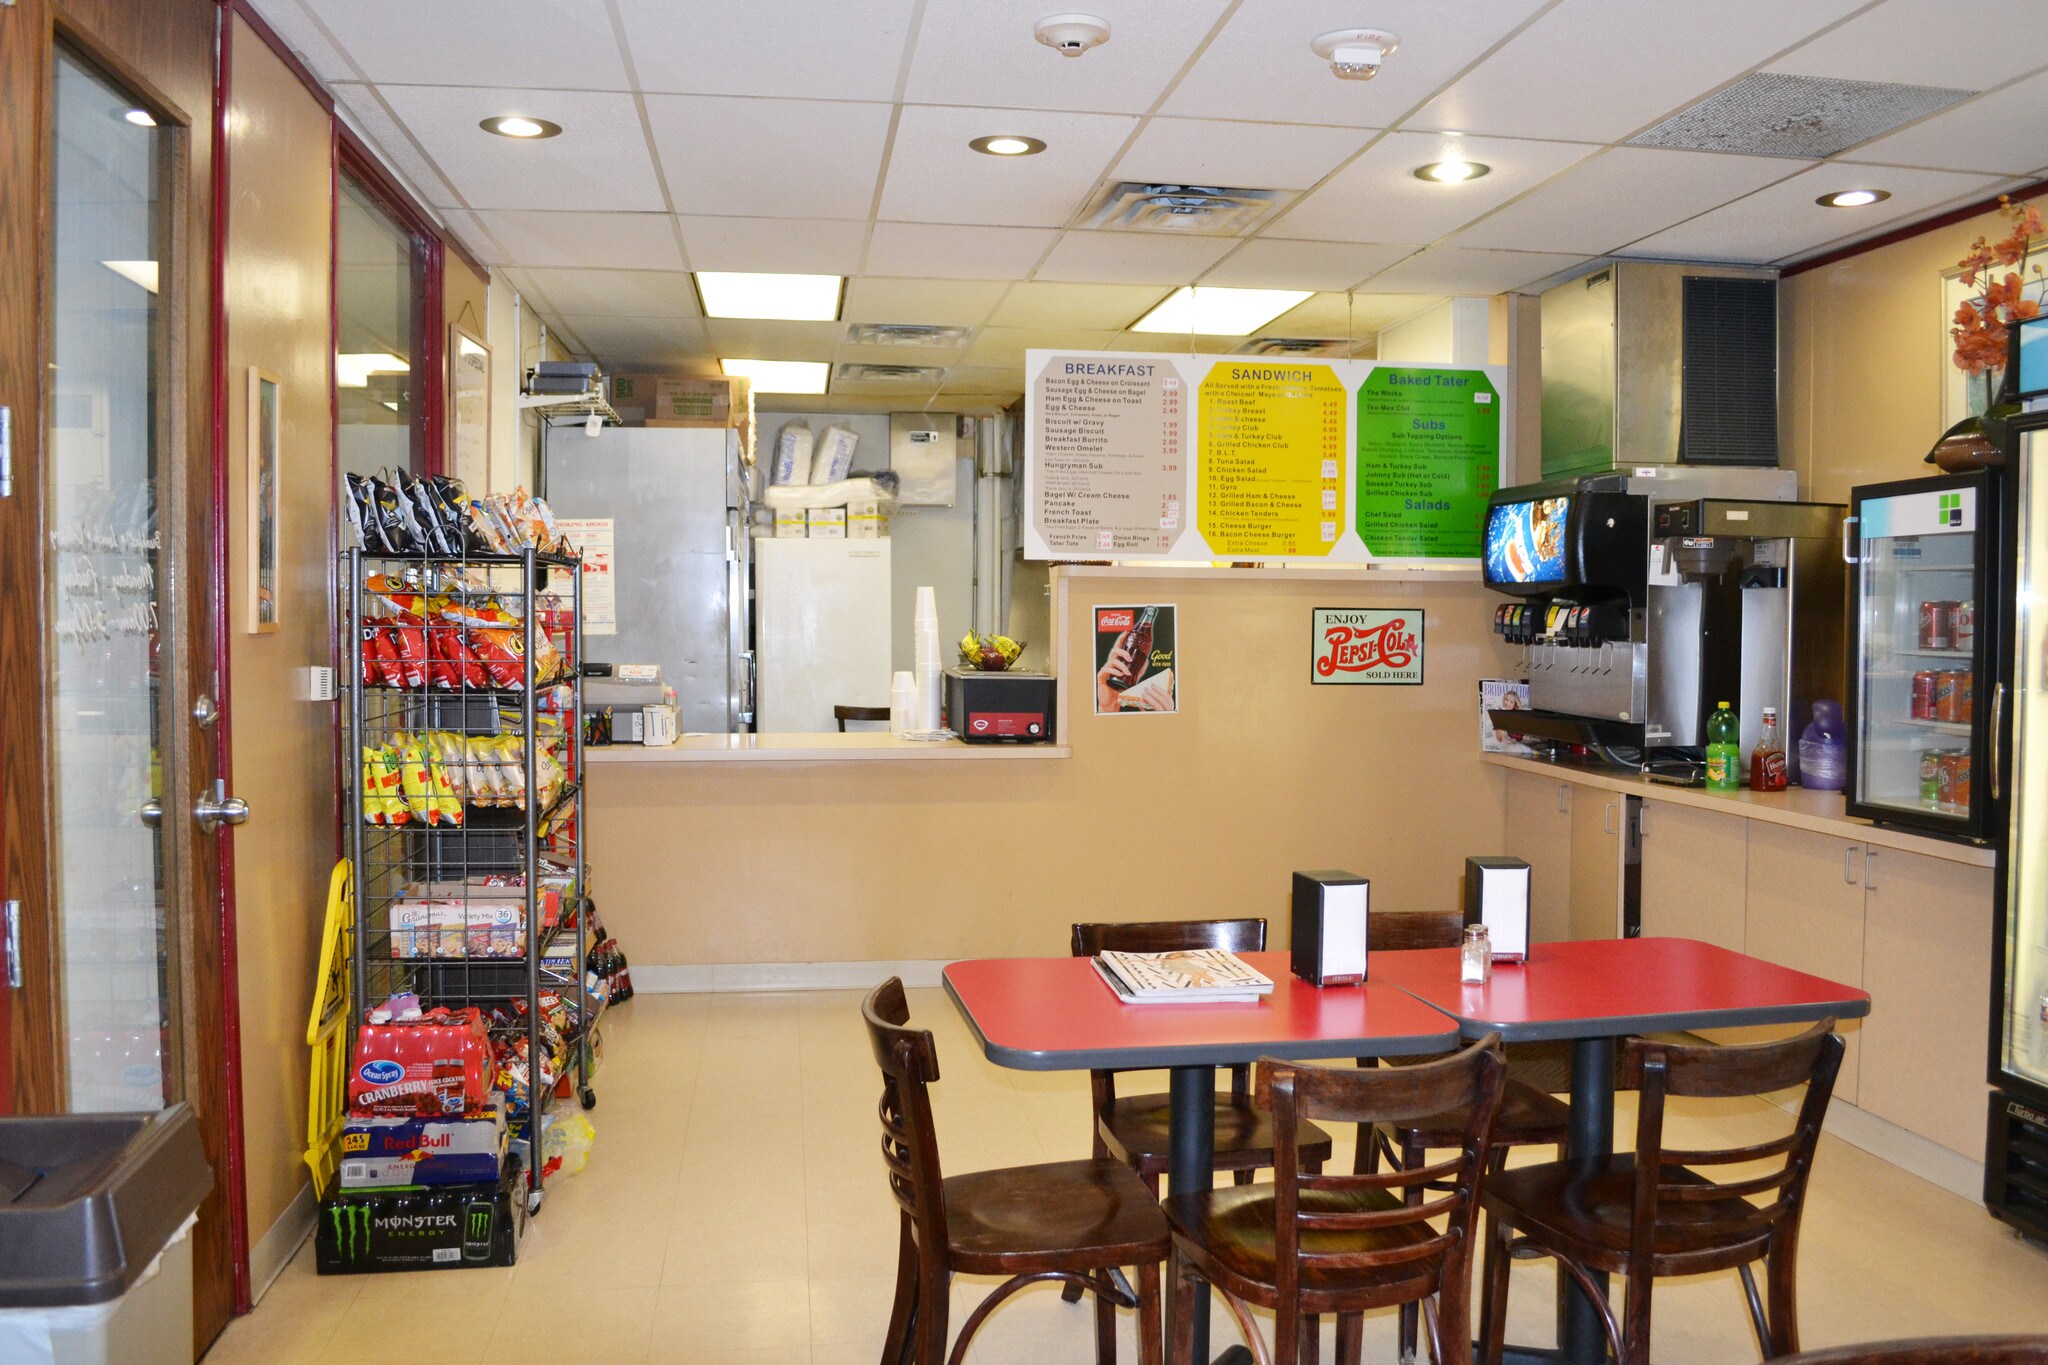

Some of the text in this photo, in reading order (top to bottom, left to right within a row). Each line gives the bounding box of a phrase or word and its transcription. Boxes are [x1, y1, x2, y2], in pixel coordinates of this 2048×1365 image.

[1357, 32, 1382, 41] FIRE
[1065, 363, 1155, 376] BREAKFAST
[1232, 368, 1312, 382] SANDWICH
[1389, 374, 1469, 387] Baked Tater
[1413, 419, 1445, 430] Subs
[1405, 499, 1450, 510] Salads
[1101, 616, 1131, 626] Coca-Cola
[1325, 614, 1367, 624] ENJOY
[1151, 650, 1173, 663] Good
[1366, 671, 1418, 679] SOLD HERE
[645, 709, 670, 741] Tip
[497, 910, 509, 918] 36
[363, 1068, 381, 1079] Ocean
[381, 1069, 399, 1081] Spray
[358, 1080, 427, 1105] CRANBERRY
[2014, 1103, 2034, 1120] Turbo
[384, 1133, 450, 1150] Red Bull
[375, 1215, 457, 1229] MONSTER
